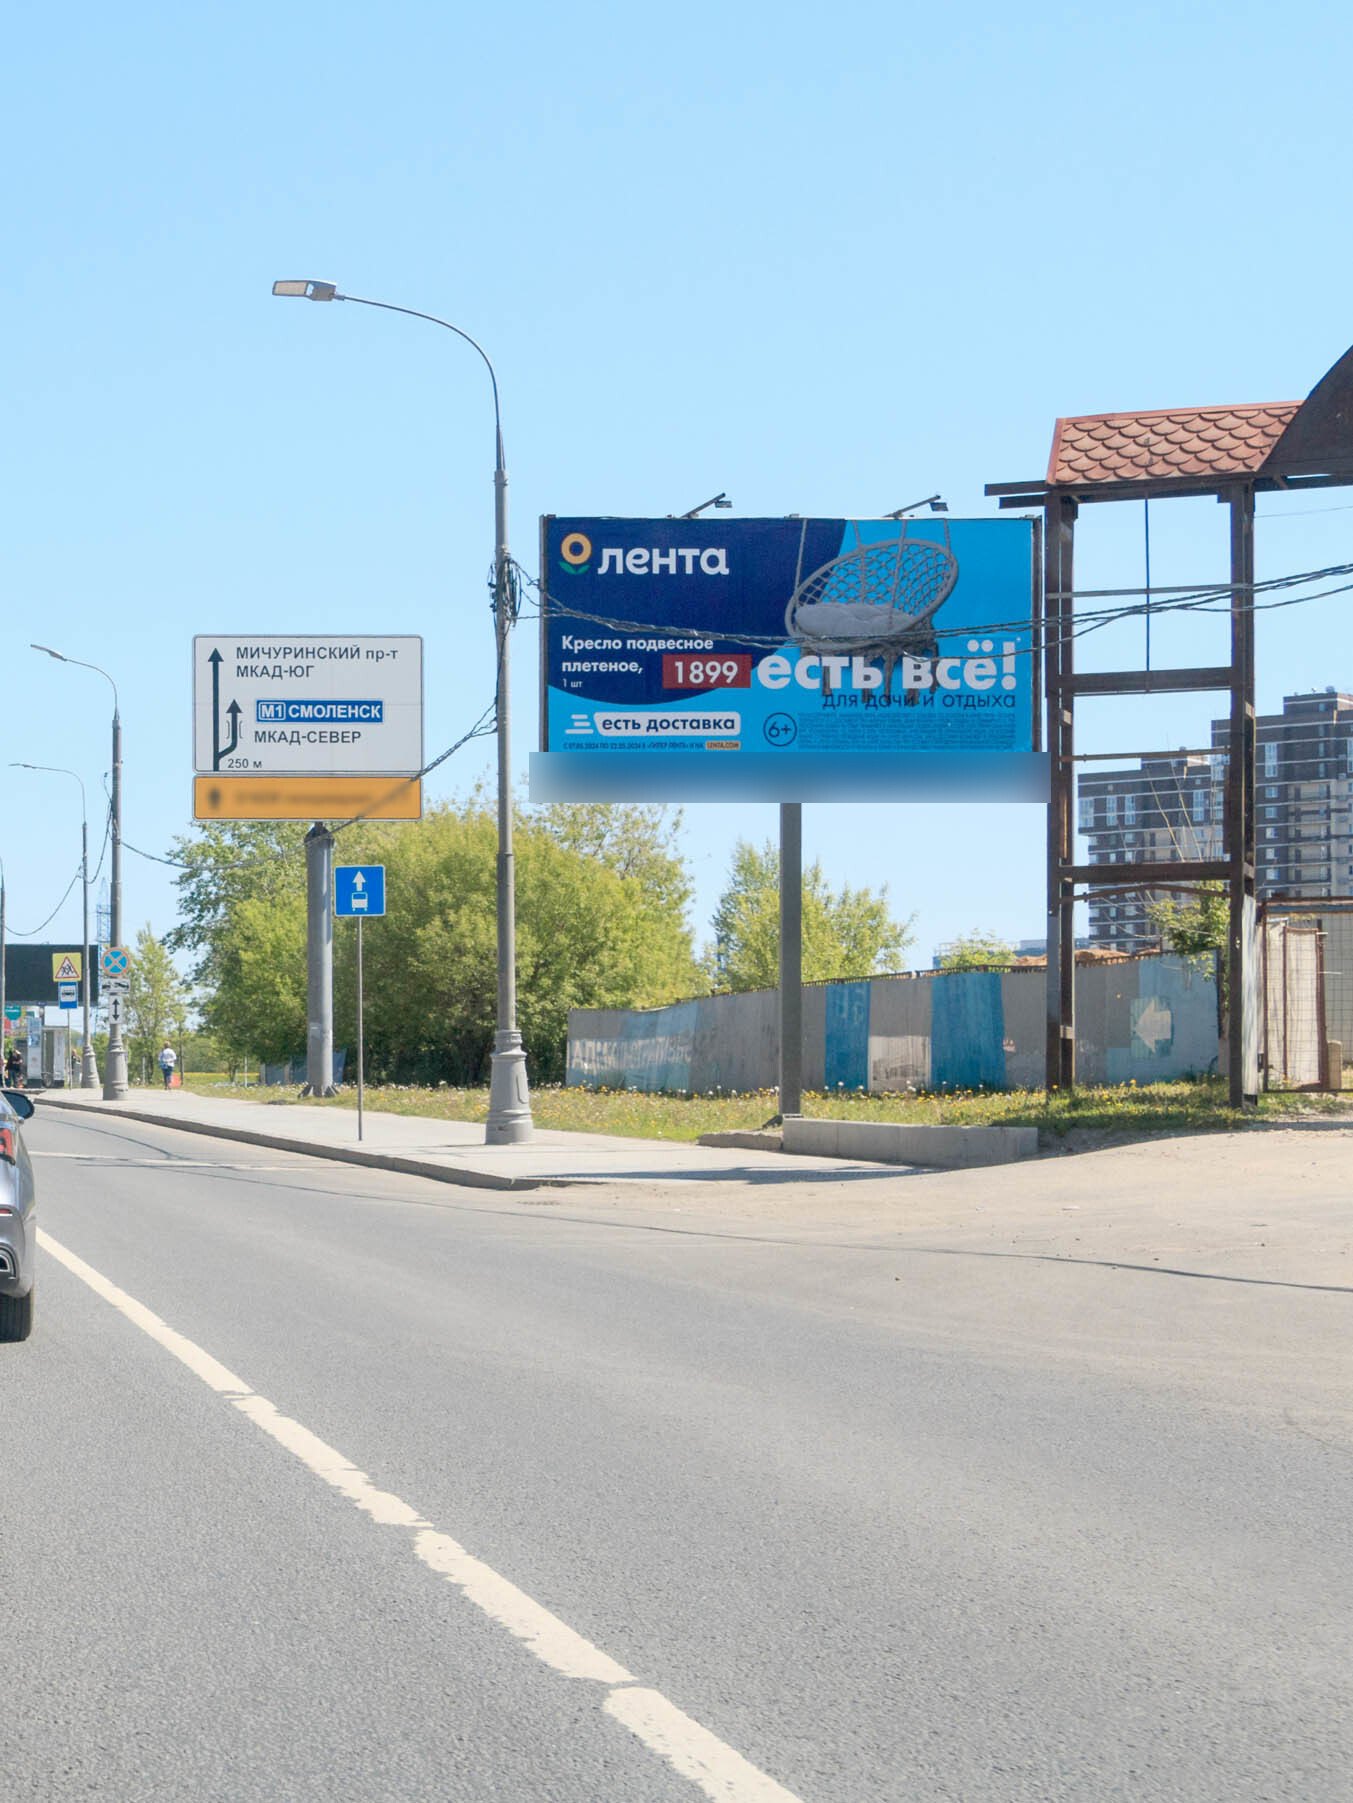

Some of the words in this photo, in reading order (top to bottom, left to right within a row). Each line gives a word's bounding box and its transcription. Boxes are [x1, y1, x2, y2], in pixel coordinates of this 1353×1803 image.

[597, 547, 730, 575] лента
[562, 635, 622, 653] Кресло
[626, 638, 714, 652] подвесное
[236, 644, 360, 660] МИЧУРИНСКИЙ
[366, 649, 398, 662] пр-т
[236, 665, 314, 679] МКАД-ЮГ
[562, 661, 643, 674] плетеное,
[674, 660, 738, 684] 1899
[757, 654, 882, 690] есть
[562, 678, 567, 687] 1
[822, 694, 857, 710] для
[865, 694, 914, 710] дачи
[923, 694, 934, 707] и
[942, 694, 1016, 710] отдыха
[288, 704, 381, 719] СМОЛЕНСК
[602, 718, 641, 730] есть
[646, 718, 735, 732] доставка
[767, 721, 793, 738] 6+
[254, 730, 361, 745] МКАД-СЕВЕР
[227, 759, 249, 769] 250
[253, 760, 262, 769] м
